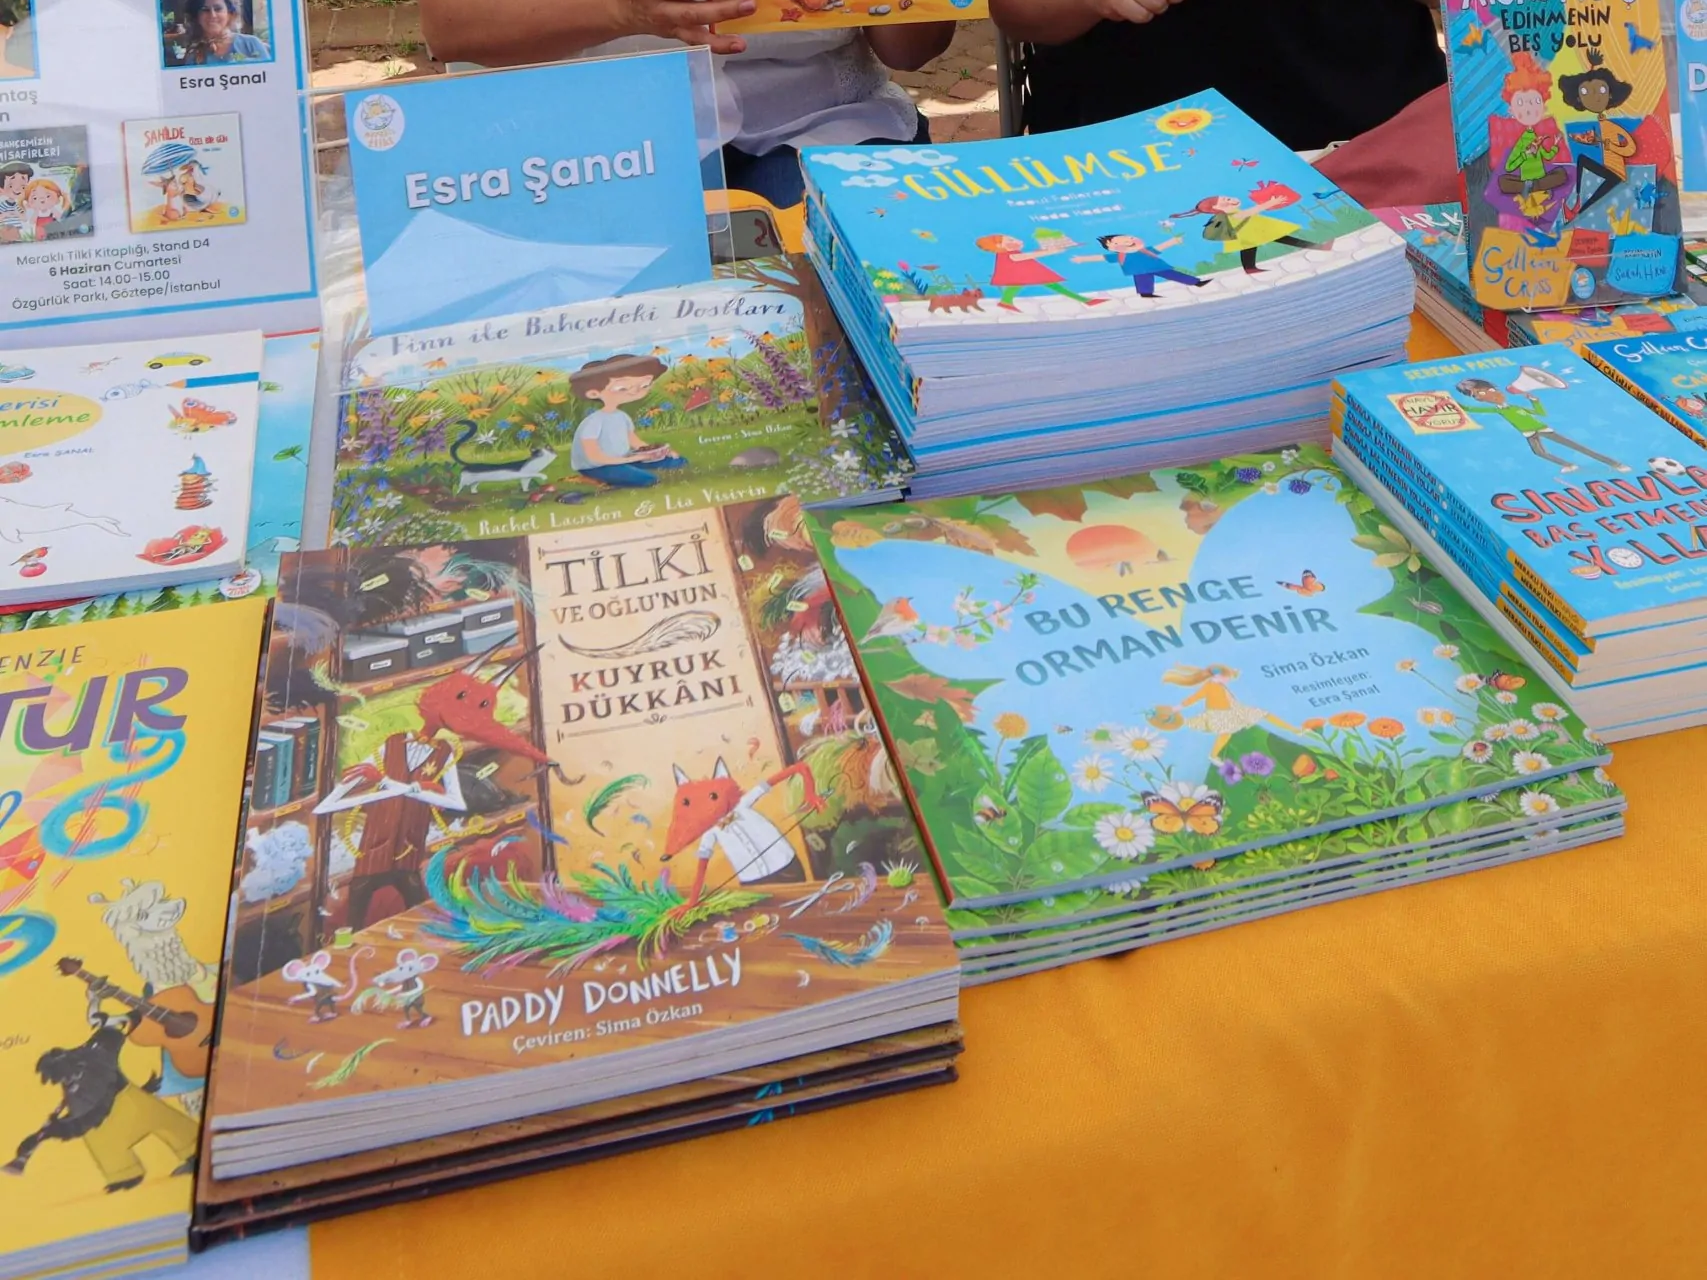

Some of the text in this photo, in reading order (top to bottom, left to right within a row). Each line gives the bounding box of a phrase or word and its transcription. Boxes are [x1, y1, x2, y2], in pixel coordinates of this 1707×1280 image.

[1500, 4, 1611, 31] EDİNMENİN
[1509, 30, 1603, 57] BEŞ YOLU
[179, 71, 267, 91] Esra Şanal
[144, 126, 186, 148] SAHİLDE
[405, 140, 656, 209] Esra Şanal
[902, 141, 1183, 202] GÜLÜMSE
[16, 238, 210, 266] Meraklı Tilki Kitaplığı, Stand D4
[49, 255, 182, 277] 6 Haziran Cumartesi
[12, 279, 221, 311] Özgürlük Parkı, Göztepe/İstanbul
[63, 270, 171, 291] Saat: 14.00-15.00
[391, 295, 787, 357] Finn ile Bahçedeki Dostları
[479, 516, 540, 537] Rachel
[634, 500, 655, 518] &
[665, 493, 694, 512] Lia
[1521, 522, 1598, 548] BAŞ
[545, 533, 714, 597] TİLKİ
[550, 583, 718, 625] VE OĞLU'NUN
[1024, 575, 1263, 637] BU RENGE
[1015, 604, 1339, 687] ORMAN DENİR
[1260, 645, 1371, 680] Sima Özkan
[569, 649, 727, 694] KUYRUK
[1291, 671, 1373, 697] Resimleyen:
[561, 673, 744, 724] DÜKKÂNI
[1308, 684, 1381, 709] Esra Şanal
[461, 946, 742, 1037] PADDY DONNELLY
[513, 1002, 704, 1055] Çeviren: Sima Özkan
